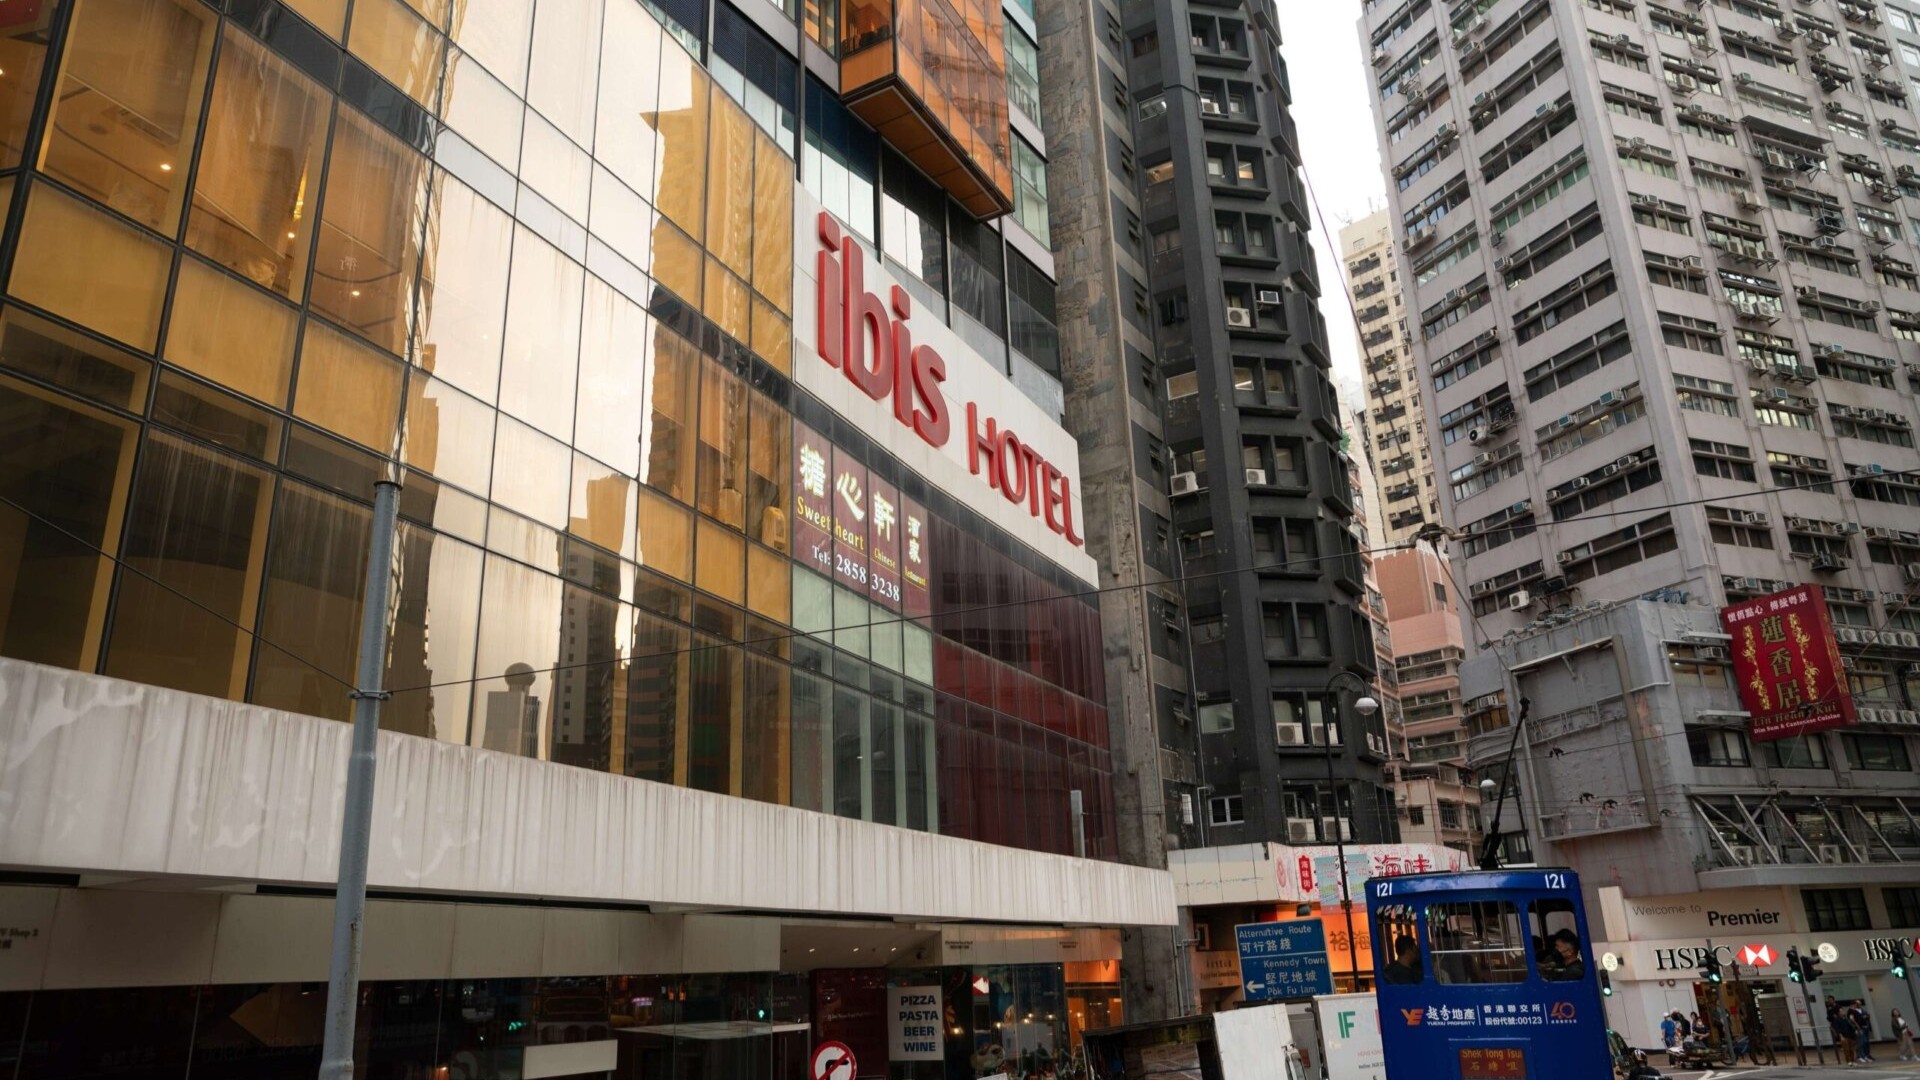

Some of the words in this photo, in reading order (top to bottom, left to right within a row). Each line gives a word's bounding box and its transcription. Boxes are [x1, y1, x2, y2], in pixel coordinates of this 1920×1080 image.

[818, 211, 950, 448] ibis
[967, 401, 1083, 547] HOTEL
[874, 548, 896, 569] Chinese
[812, 545, 831, 566] Tel:
[836, 554, 867, 584] 2858
[872, 573, 900, 602] 3238
[1759, 614, 1802, 710] 蓮香居
[1753, 713, 1771, 727] Lin
[1815, 702, 1837, 715] Kui
[1754, 726, 1766, 734] Dim
[1767, 724, 1779, 732] Sum
[1817, 712, 1841, 723] Cuisine
[1544, 874, 1566, 889] 121
[1376, 882, 1393, 897] 121
[1632, 904, 1686, 916] Welcome
[1691, 904, 1701, 913] to
[1707, 908, 1780, 927] Premier
[1239, 927, 1283, 938] Alternative
[1288, 925, 1311, 935] Route
[1263, 959, 1300, 968] Kennedy
[1303, 956, 1326, 965] Town
[1265, 970, 1318, 985] 堅尼地城
[1267, 986, 1282, 996] Pok
[1287, 986, 1297, 994] Fu
[901, 995, 936, 1006] PIZZA
[899, 1010, 939, 1021] PASTA
[1426, 1004, 1476, 1021] 越秀地產
[1483, 1003, 1541, 1014] 香港聯交所
[904, 1026, 935, 1037] BEER
[904, 1042, 936, 1053] WINE
[1462, 1050, 1482, 1058] Shek
[1485, 1050, 1503, 1061] Tong
